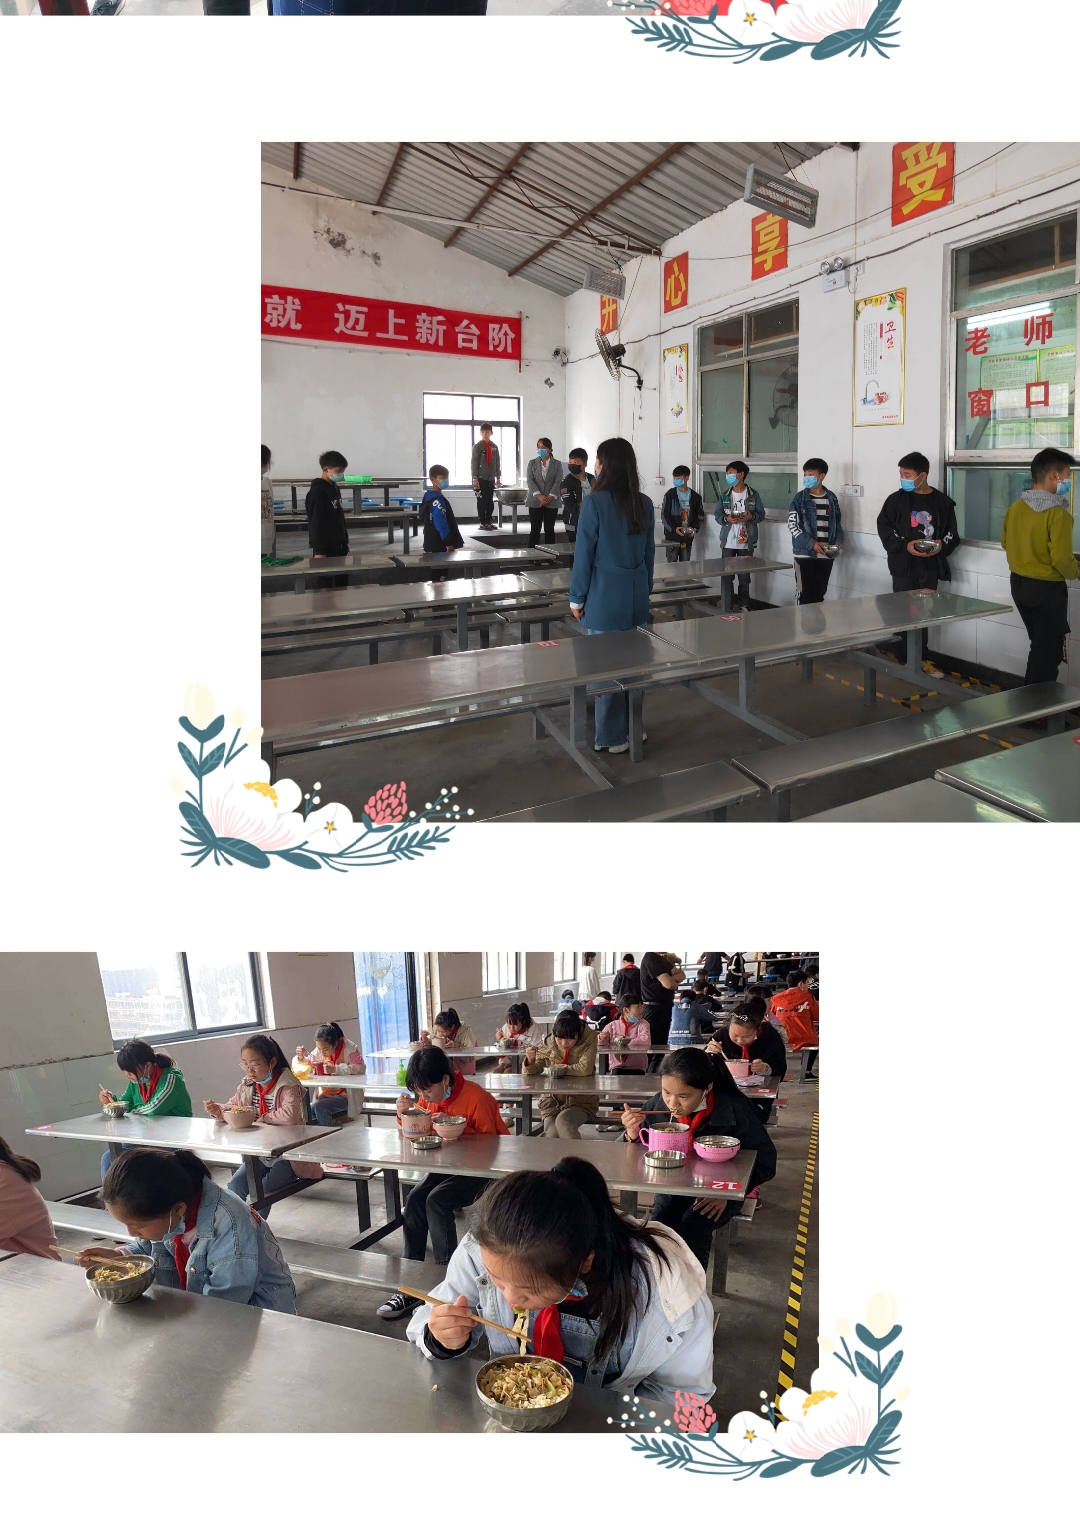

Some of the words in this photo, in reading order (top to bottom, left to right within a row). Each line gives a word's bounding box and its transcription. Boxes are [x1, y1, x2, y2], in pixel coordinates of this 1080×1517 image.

[665, 261, 686, 307] 心
[753, 212, 786, 272] 享
[898, 142, 947, 216] 受
[264, 294, 302, 331] 就
[333, 302, 516, 354] 迈上新台阶
[964, 312, 1055, 356] 老师
[967, 380, 1050, 419] 窗口
[711, 1180, 738, 1190] 12
